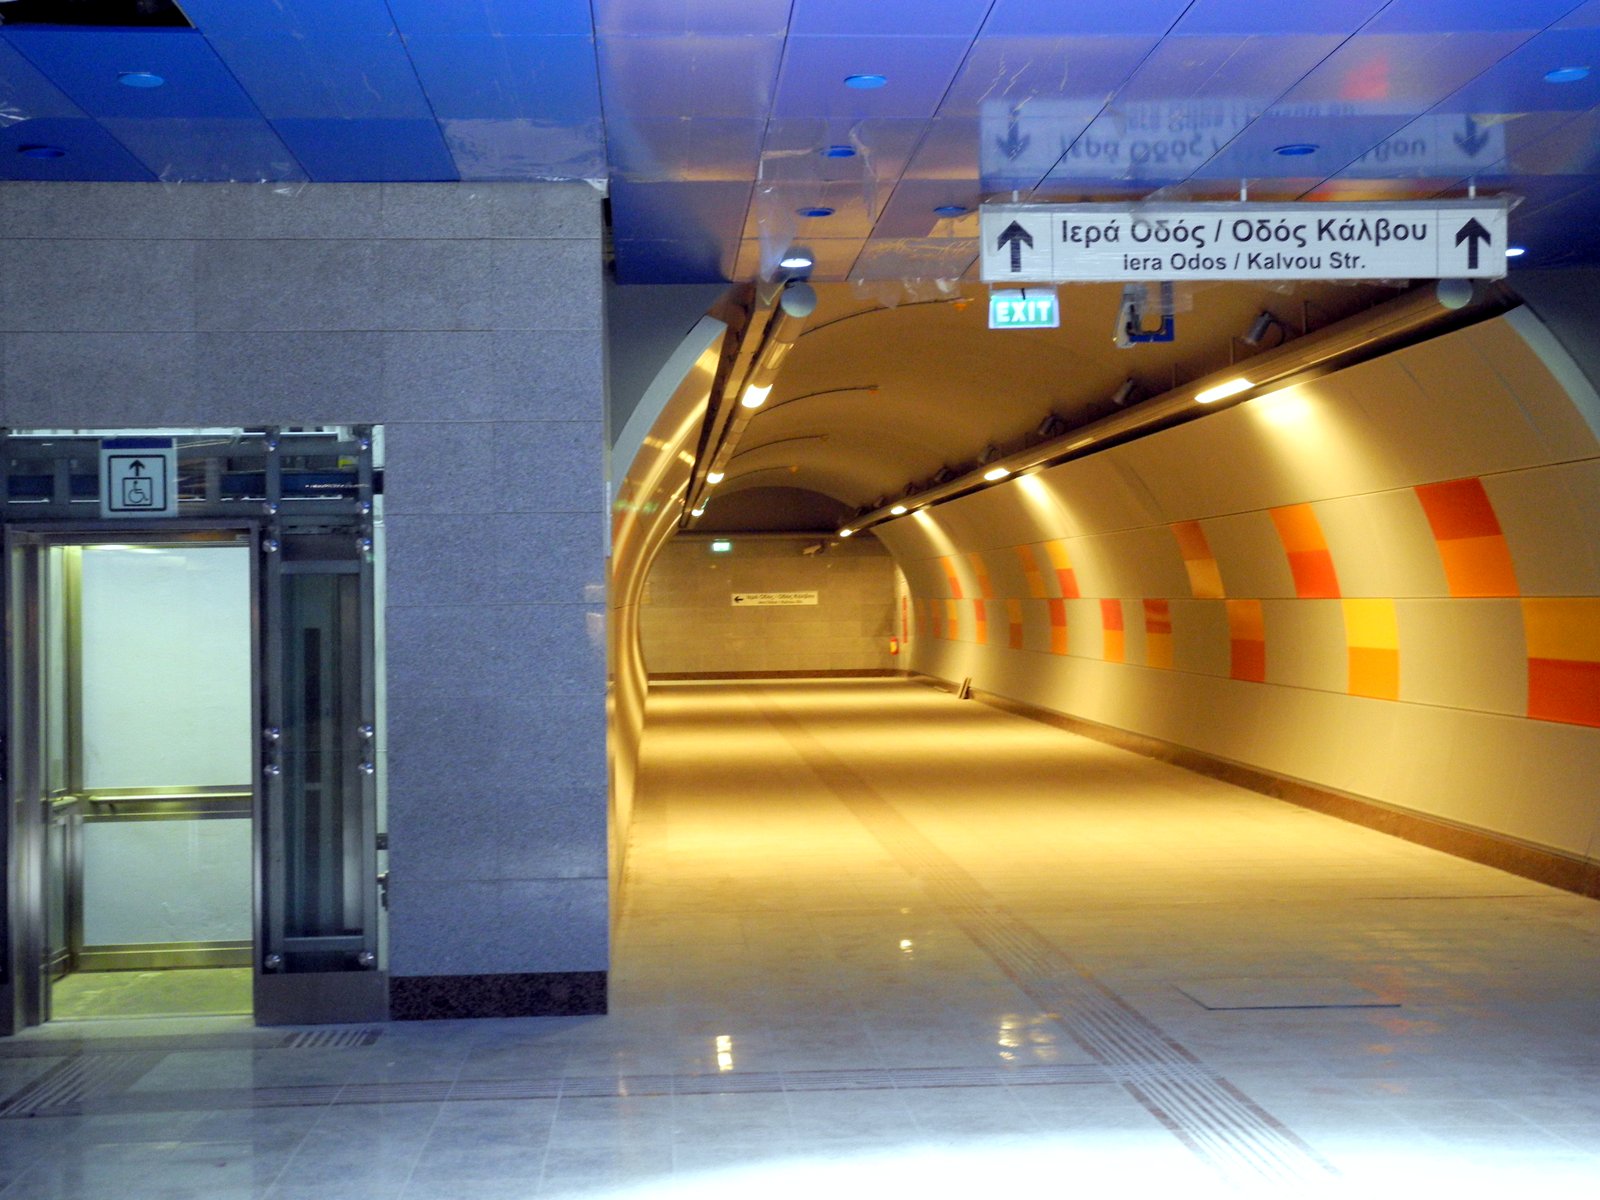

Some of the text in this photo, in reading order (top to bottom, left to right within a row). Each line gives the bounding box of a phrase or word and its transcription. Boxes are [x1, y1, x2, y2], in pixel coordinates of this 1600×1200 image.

[1062, 217, 1427, 249] Ιερά Οδός / Οδός Κάλβου
[1170, 252, 1227, 270] Odos
[1233, 253, 1240, 270] /
[1248, 251, 1321, 270] Kalvou
[1329, 251, 1366, 270] Str.
[996, 300, 1052, 323] EXIT
